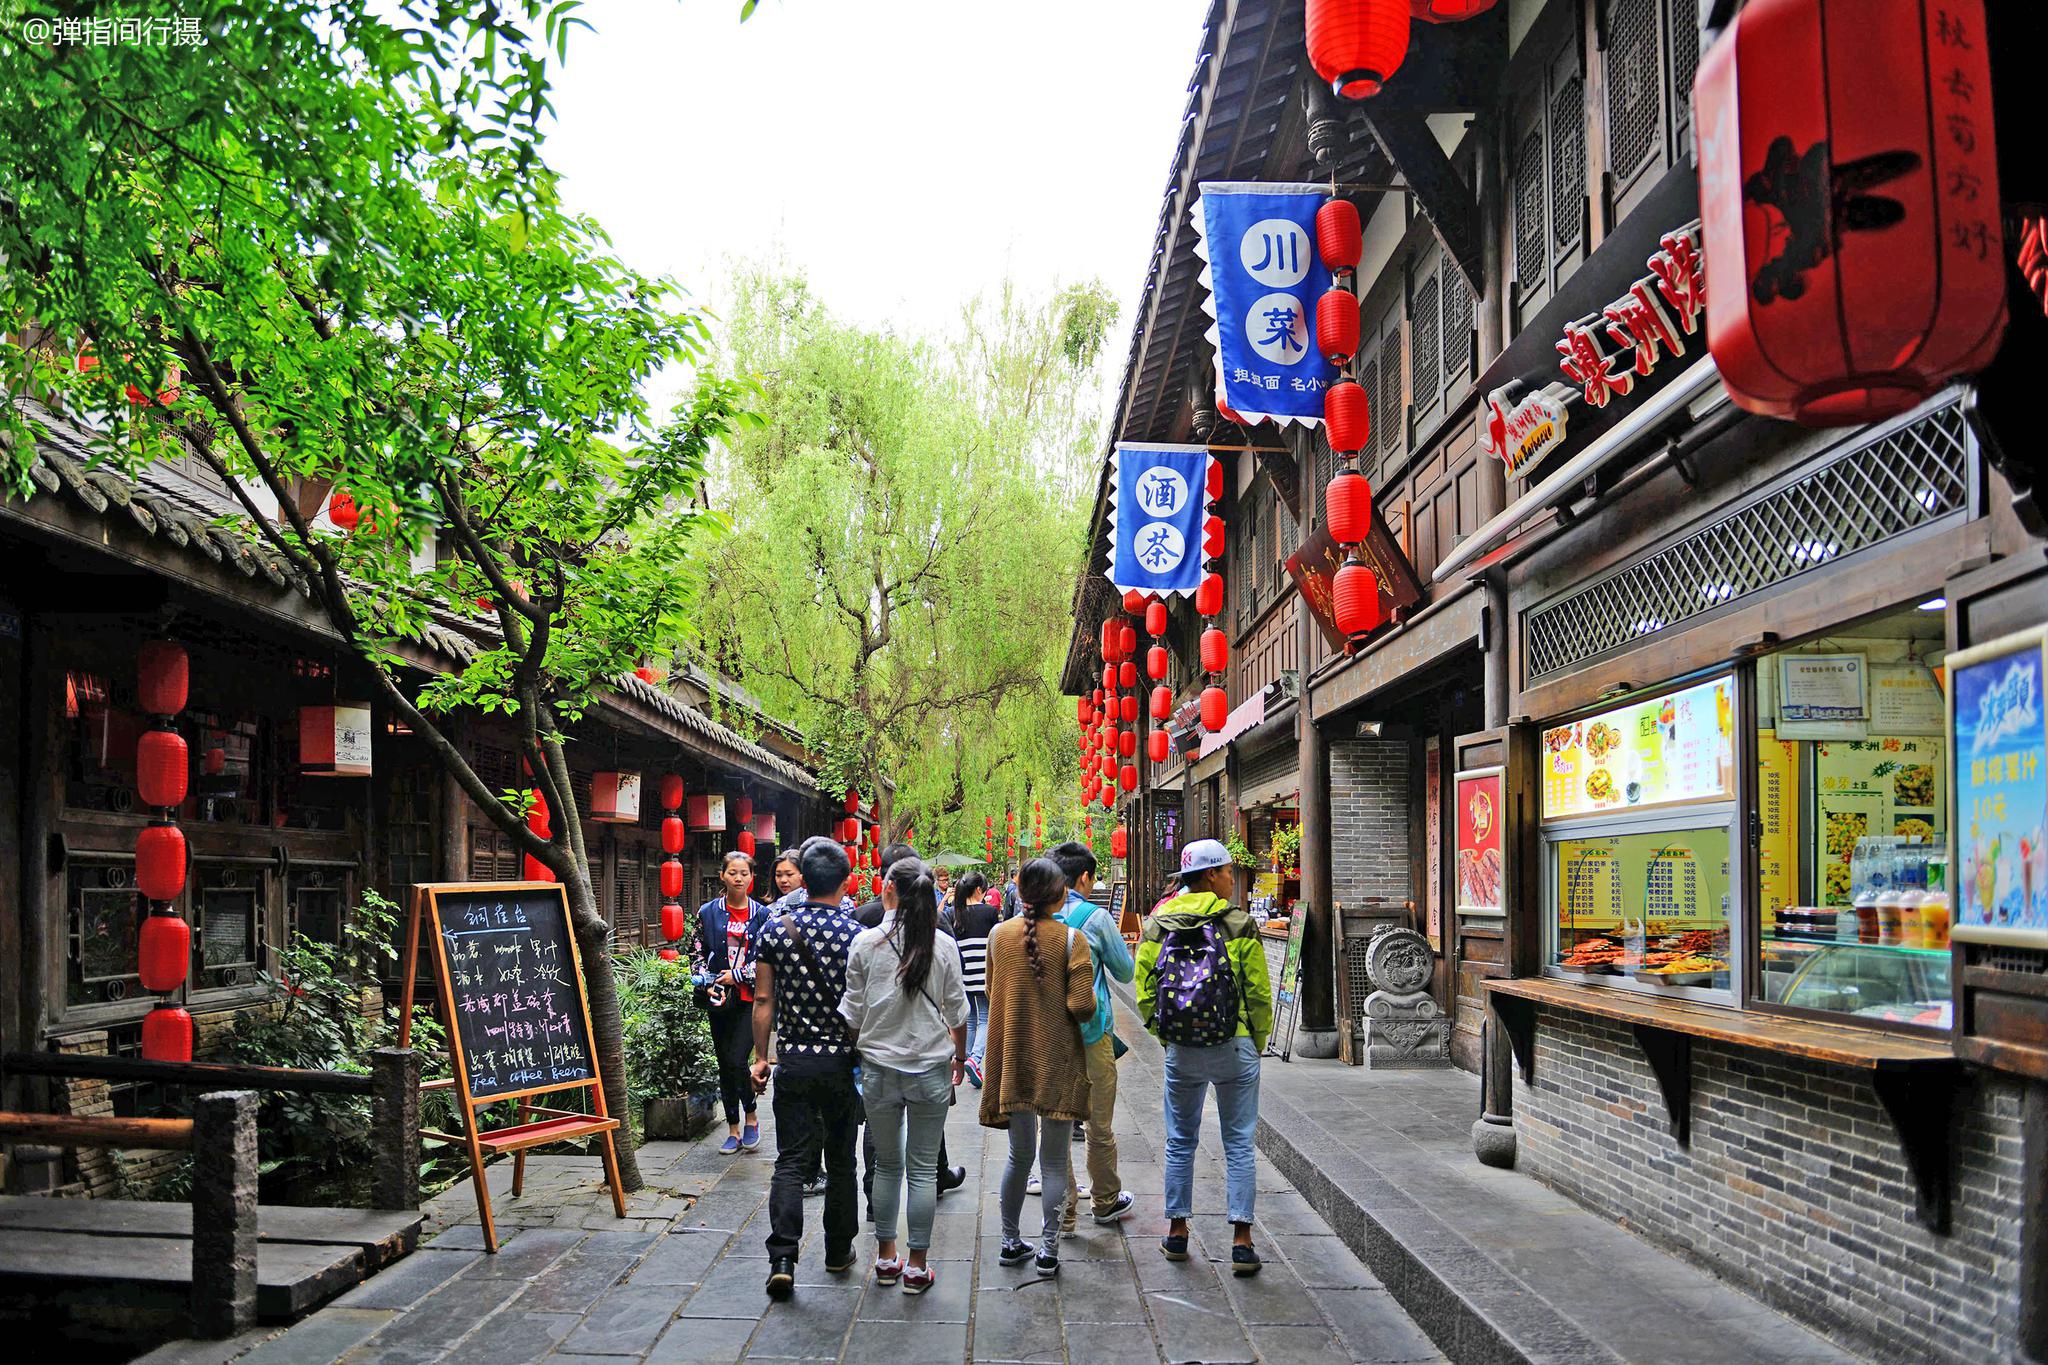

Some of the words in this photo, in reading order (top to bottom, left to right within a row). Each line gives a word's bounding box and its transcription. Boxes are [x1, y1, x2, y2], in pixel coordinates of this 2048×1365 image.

[1849, 737, 1917, 752] 澳洲烤肉
[530, 938, 558, 961] 果汁
